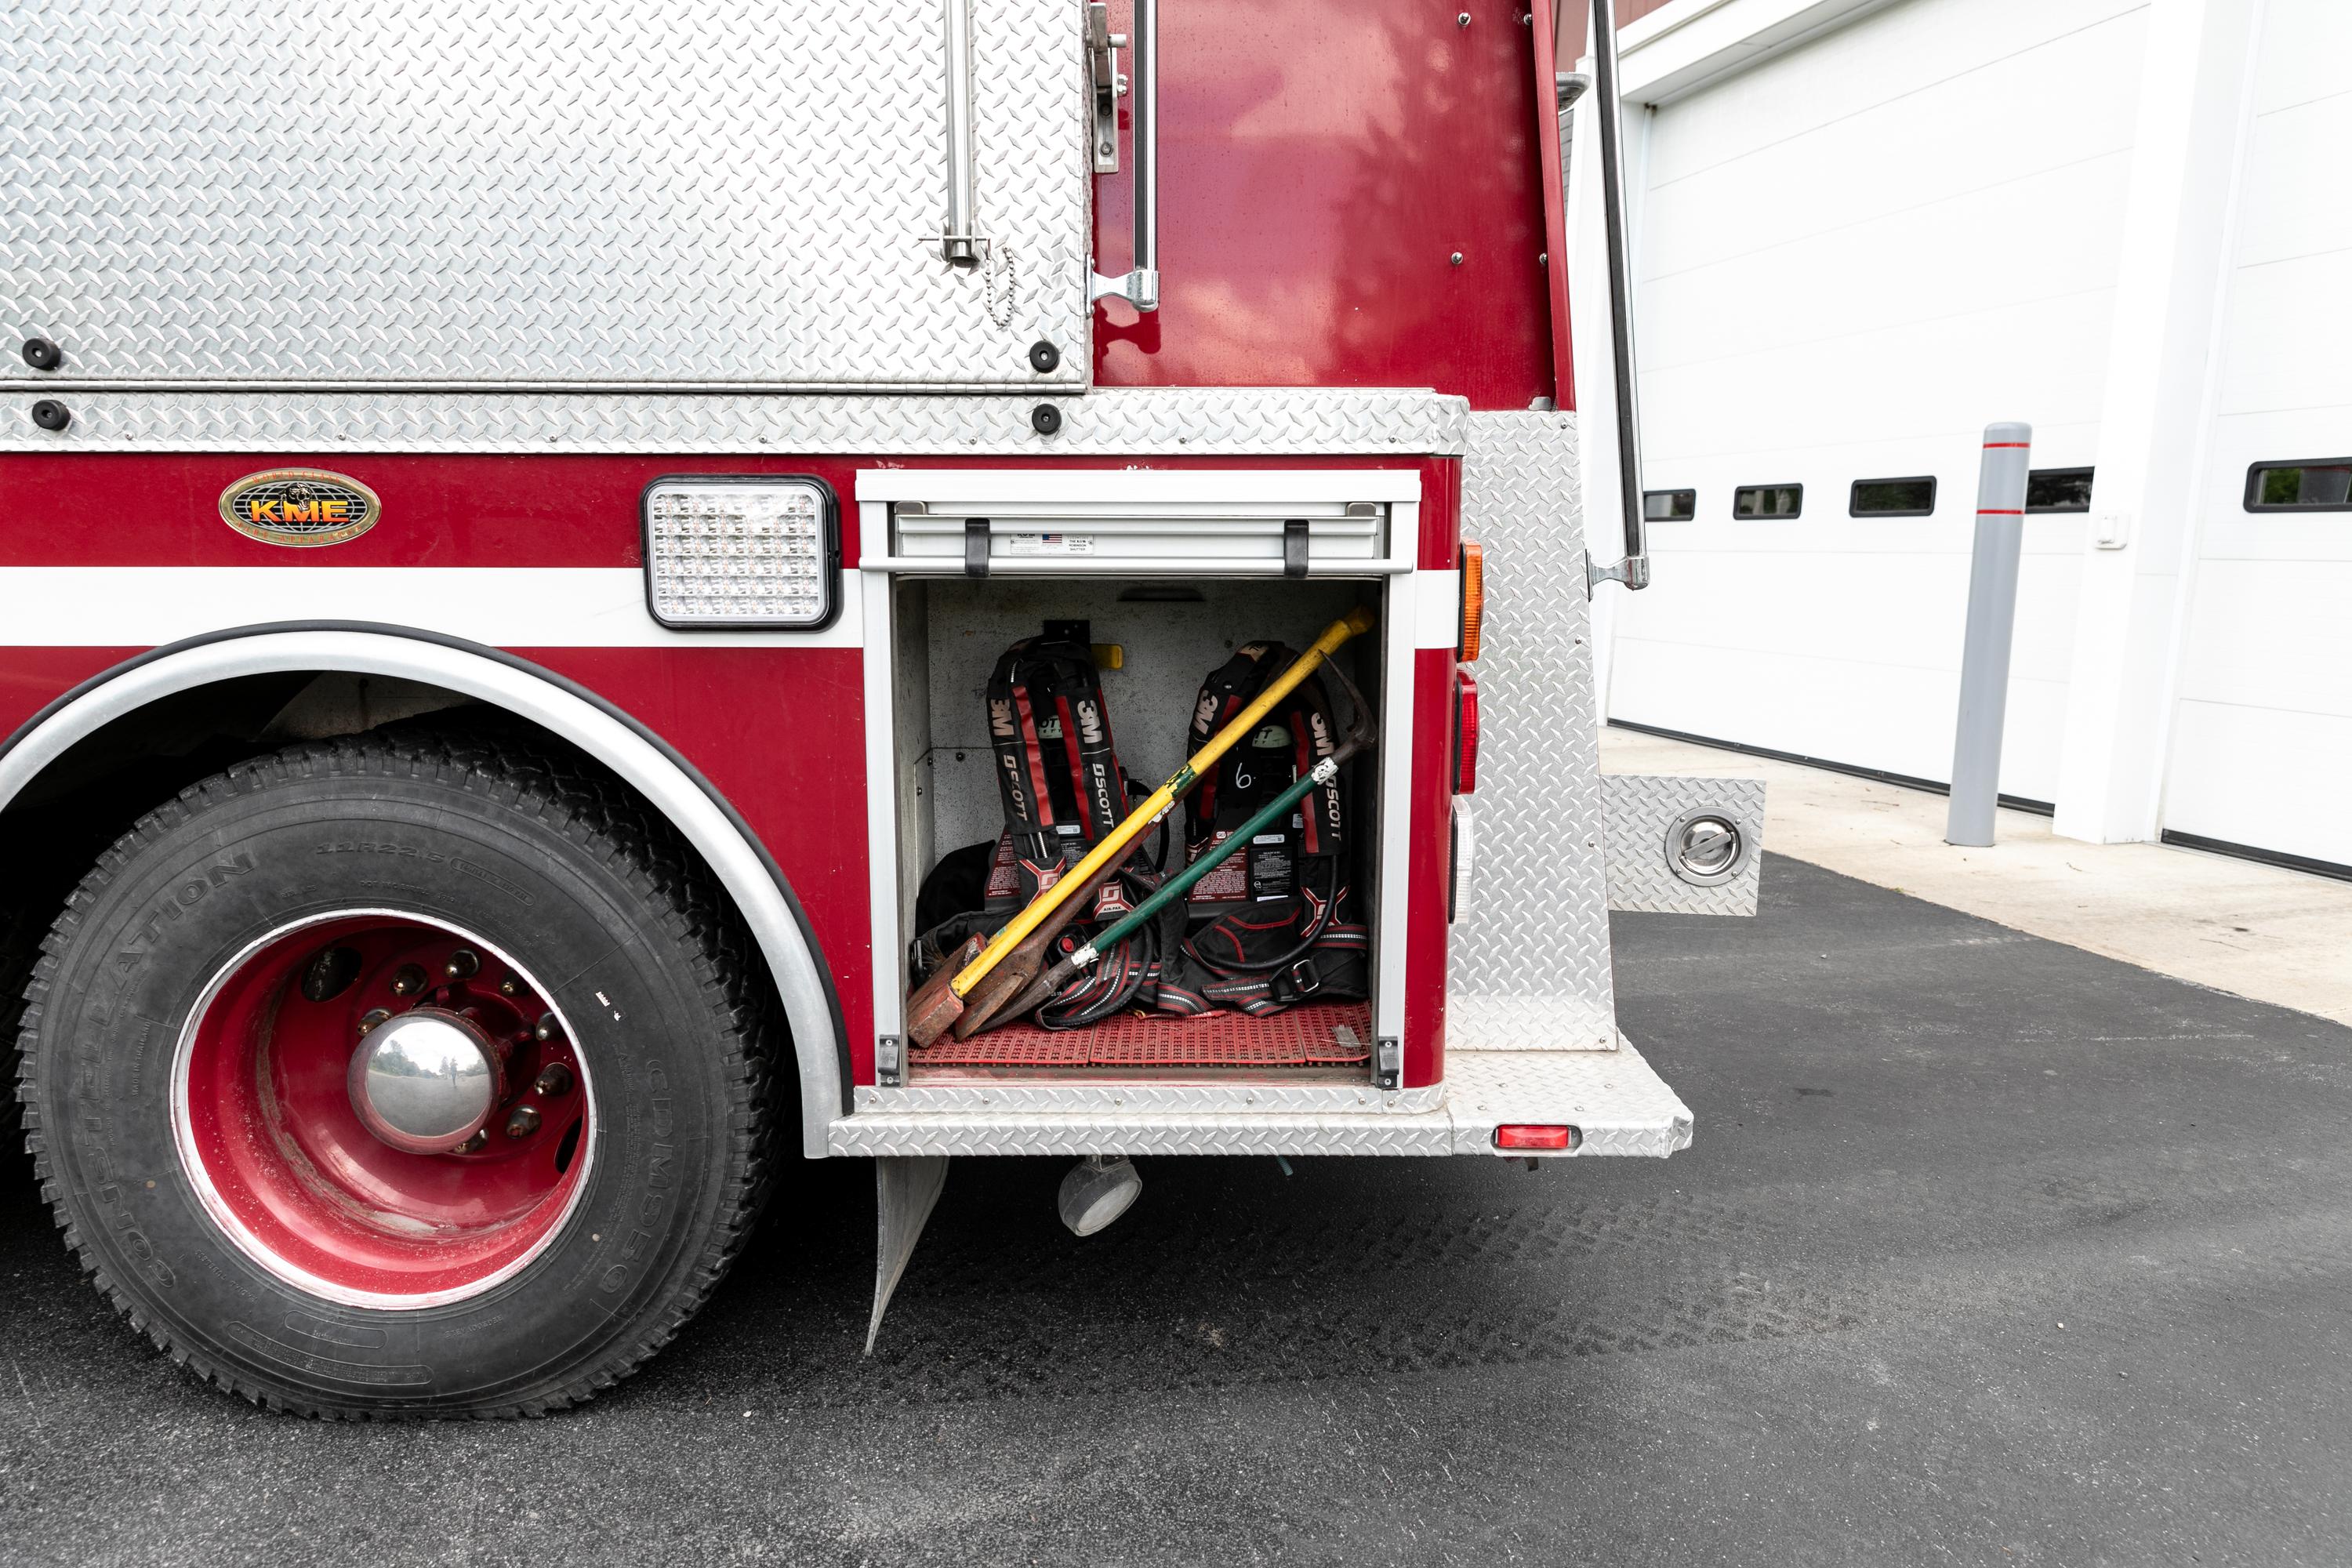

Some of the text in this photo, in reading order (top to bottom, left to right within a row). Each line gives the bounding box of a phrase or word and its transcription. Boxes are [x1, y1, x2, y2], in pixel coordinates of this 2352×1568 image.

[250, 500, 350, 523] KME
[990, 698, 1015, 736] 3M
[1077, 699, 1103, 744] 3M
[1193, 689, 1218, 735] 3M
[1311, 712, 1333, 757] 3M
[1235, 762, 1252, 789] 6
[1096, 777, 1114, 829] SCOTT
[1326, 787, 1341, 841] SCOTT
[315, 840, 446, 864] 11R22.5
